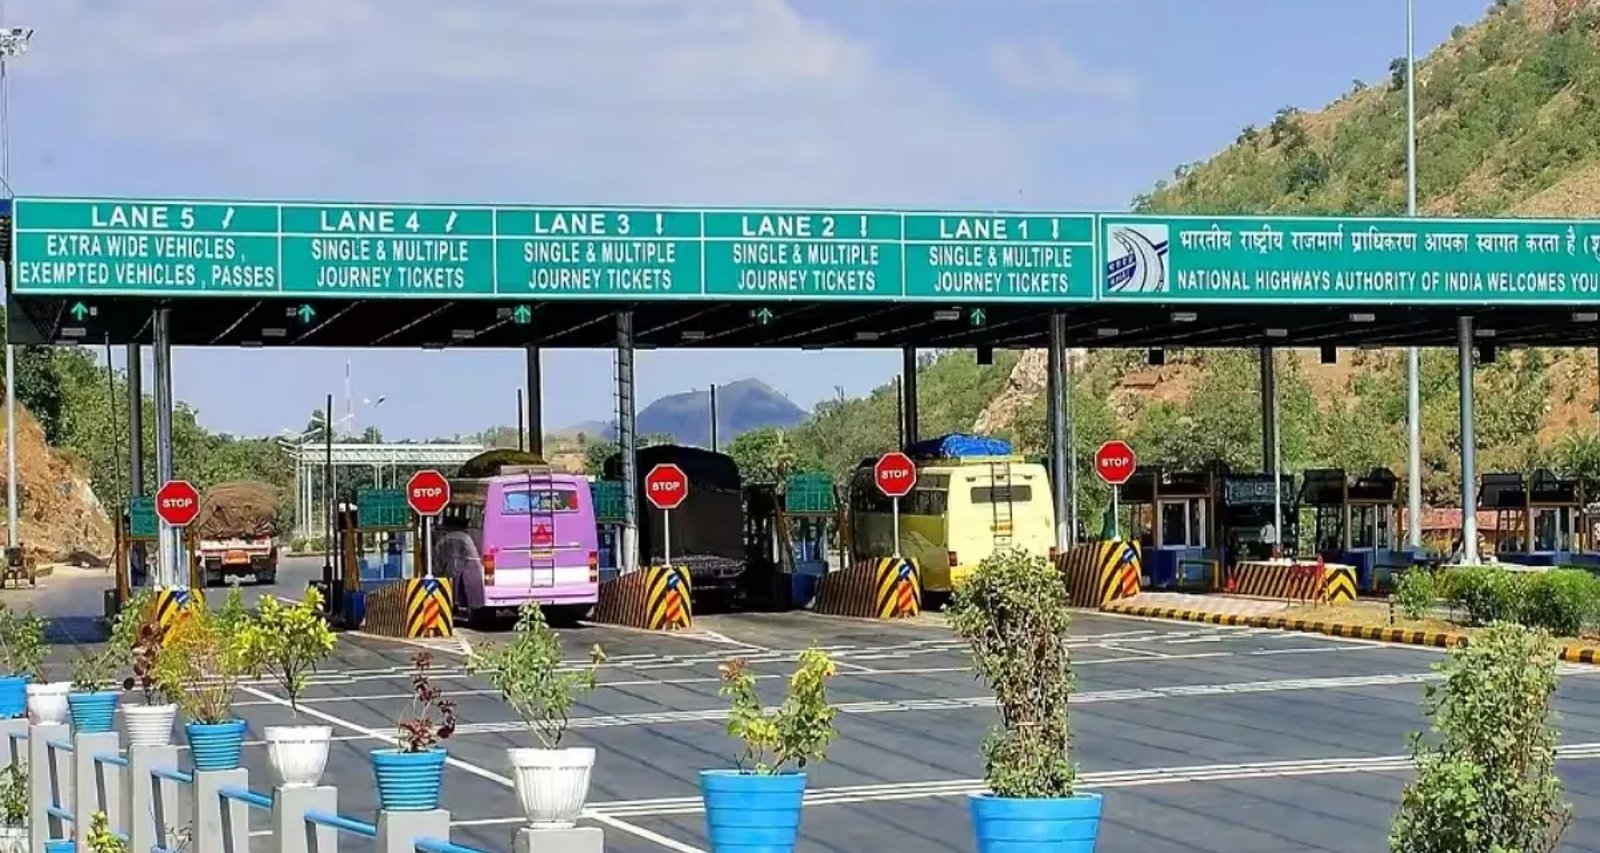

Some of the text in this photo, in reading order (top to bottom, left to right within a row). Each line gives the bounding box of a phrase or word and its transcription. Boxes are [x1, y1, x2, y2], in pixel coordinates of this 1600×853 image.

[91, 206, 195, 229] LANE 5
[320, 210, 420, 232] LANE 4
[535, 213, 630, 234] LANE 3
[741, 215, 834, 237] LANE 2
[940, 218, 1029, 239] LANE 1
[47, 235, 101, 256] EXTRA
[107, 236, 148, 257] WIDE
[312, 239, 468, 261] SINGLE & MULTIPLE
[1180, 224, 1231, 250] भारतीय
[1240, 224, 1283, 254] राष्ट्रीय
[1291, 224, 1343, 250] राजमार्ग
[1351, 225, 1417, 251] प्राधिकरण
[1425, 233, 1468, 251] आपका
[1476, 234, 1518, 252] स्वागत
[1526, 234, 1560, 253] करता
[1566, 225, 1576, 256] है
[524, 242, 675, 263] SINGLE & MULTIPLE
[733, 244, 879, 265] SINGLE & MULTIPLE
[929, 246, 1072, 267] SINGLE & MULTIPLE
[19, 262, 109, 284] EXEMPTED
[212, 265, 275, 287] PASSES
[316, 266, 464, 288] JOURNEY TICKETS
[528, 268, 672, 290] JOURNEY TICKETS
[737, 270, 875, 291] JOURNEY TICKETS
[934, 272, 1068, 293] JOURNEY TICKETS
[1178, 270, 1598, 292] NATIONAL HIGHWAYS AUTHORITY OF INDIA WELCOMES YOU
[1102, 458, 1128, 468] STOP
[881, 469, 909, 479] STOP
[413, 488, 442, 498] STOP
[653, 481, 681, 491] STOP
[163, 498, 193, 508] STOP
